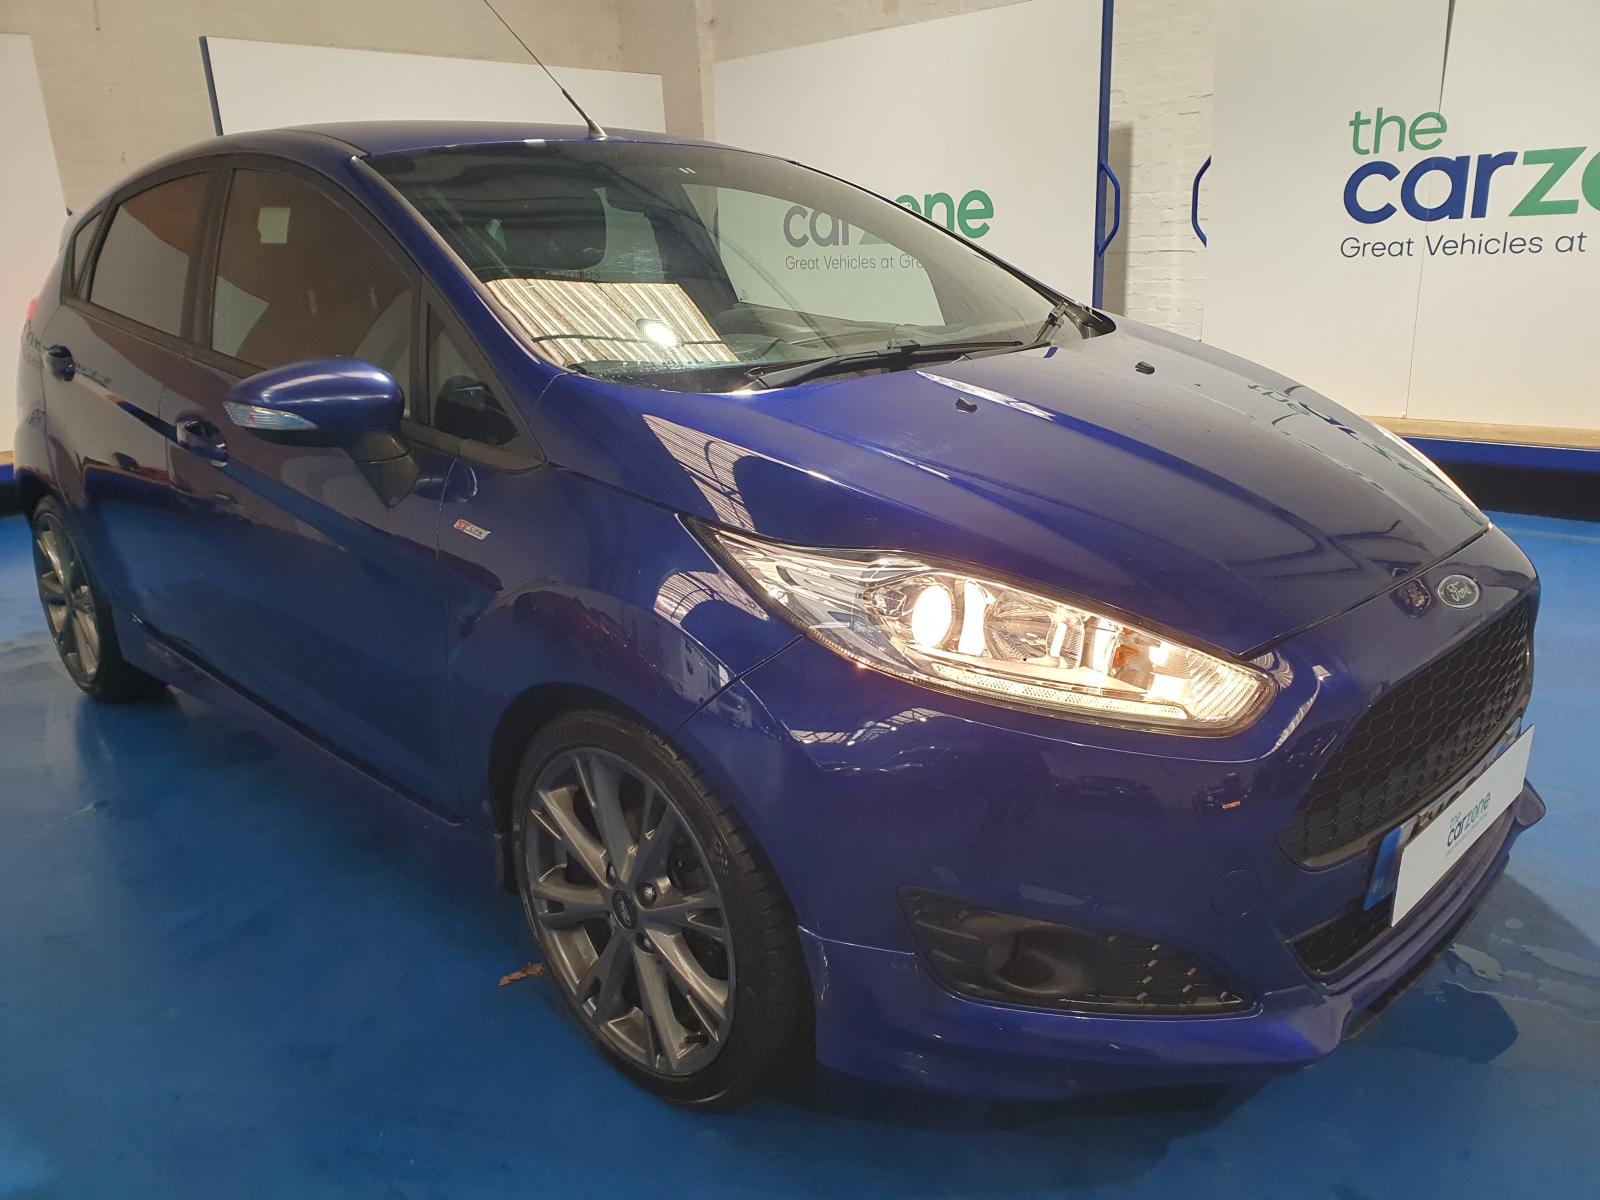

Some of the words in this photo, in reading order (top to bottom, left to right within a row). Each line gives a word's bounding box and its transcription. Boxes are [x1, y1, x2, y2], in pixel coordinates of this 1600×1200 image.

[1349, 107, 1448, 155] the
[785, 255, 820, 270] Great
[823, 254, 876, 270] Vehicles
[880, 257, 895, 269] at
[1340, 236, 1414, 258] Great
[1426, 231, 1543, 256] Vehicles
[1555, 231, 1588, 253] at
[1447, 791, 1491, 847] carzone
